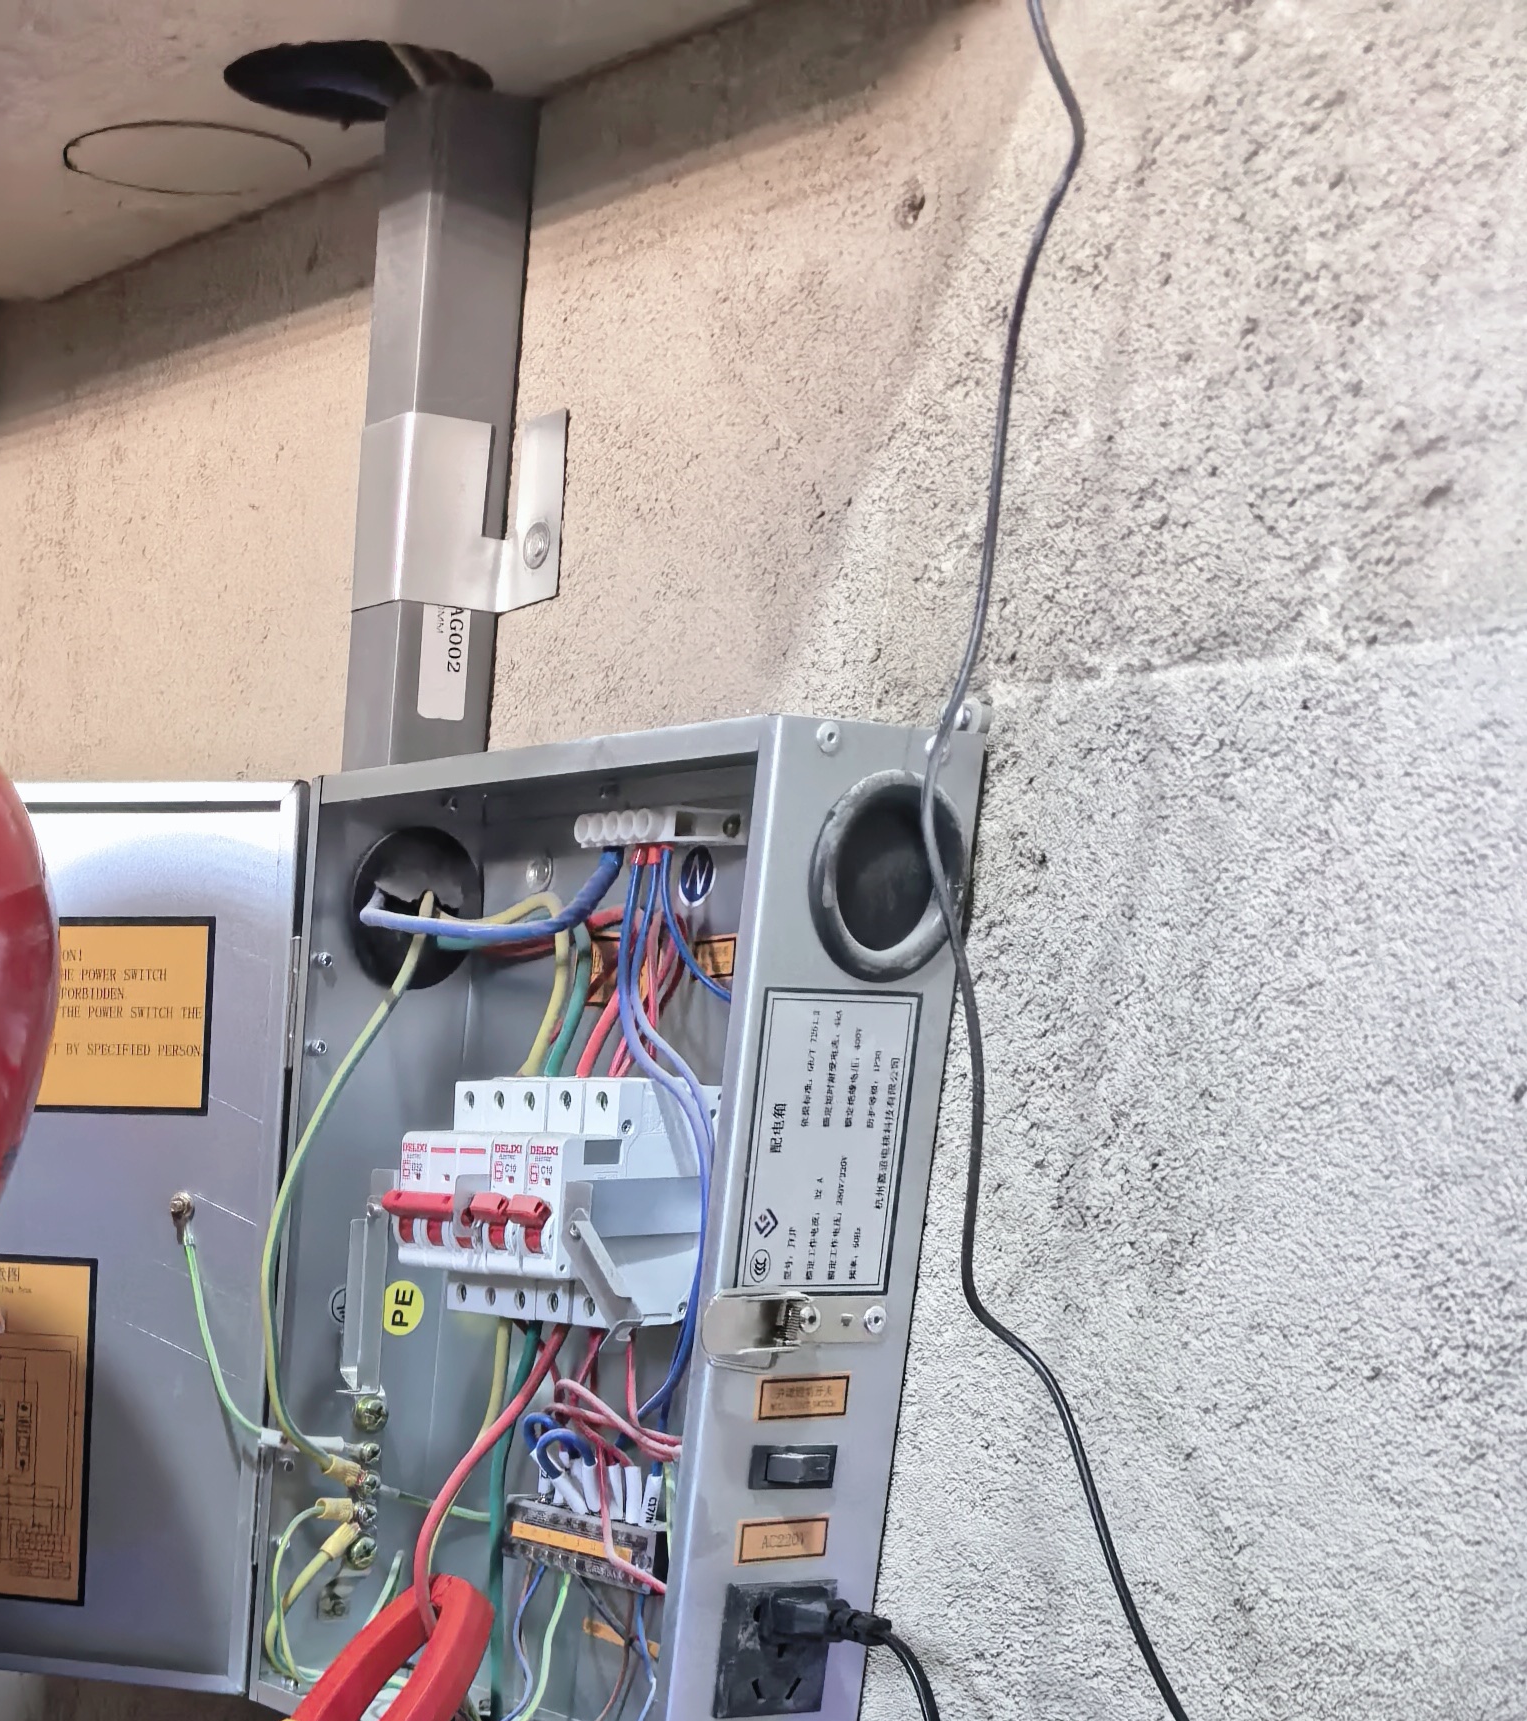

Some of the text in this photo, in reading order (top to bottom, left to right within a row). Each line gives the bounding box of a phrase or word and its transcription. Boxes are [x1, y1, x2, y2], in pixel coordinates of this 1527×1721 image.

[80, 969, 116, 982] POWER
[123, 969, 167, 982] SWITCH
[61, 1006, 202, 1020] THE POWER SWITCH THE
[66, 1043, 80, 1056] BY
[86, 1043, 151, 1057] SPECIFIED
[768, 1102, 787, 1153] 配电箱
[402, 1142, 428, 1153] DELIXI
[494, 1143, 522, 1154] DELIXI
[529, 1145, 559, 1156] DELIXI
[391, 1288, 414, 1327] PE
